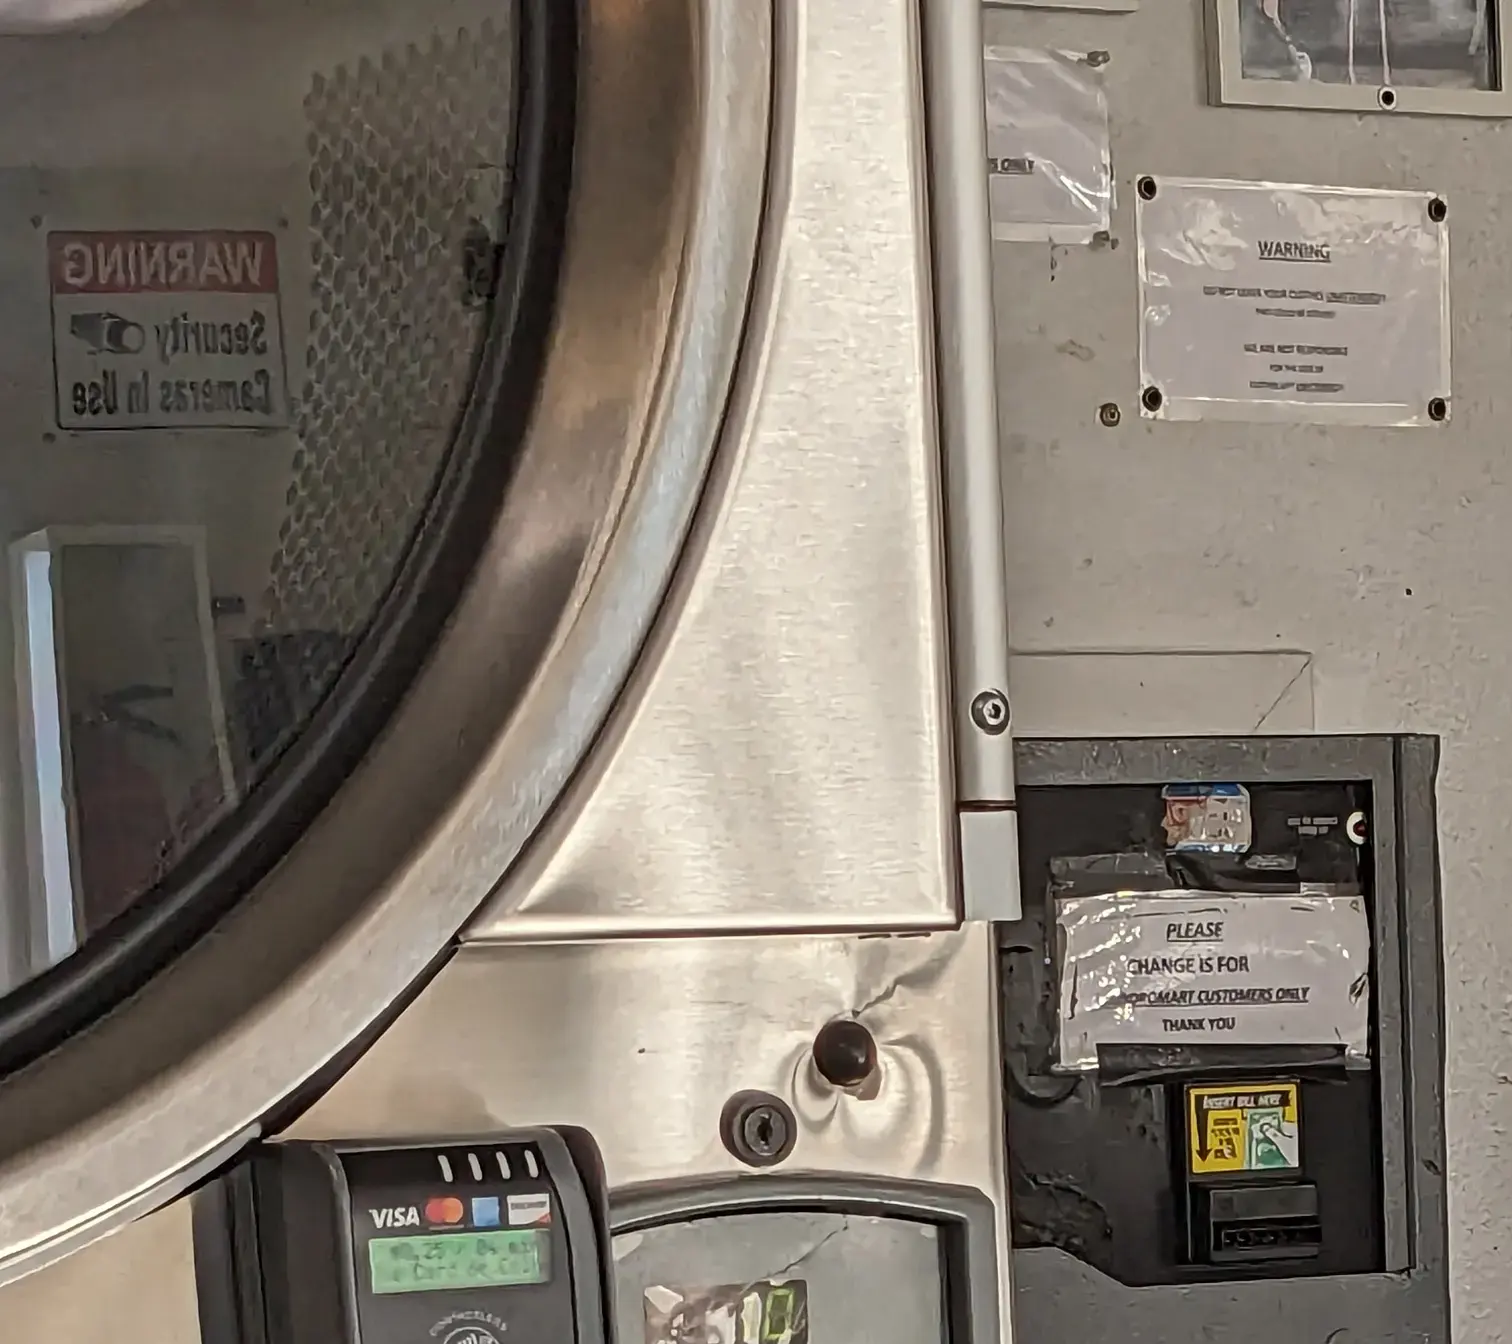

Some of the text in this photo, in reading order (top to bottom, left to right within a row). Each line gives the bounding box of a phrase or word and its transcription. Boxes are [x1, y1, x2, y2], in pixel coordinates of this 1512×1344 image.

[1258, 240, 1331, 259] WARNING
[1167, 922, 1224, 940] PLEASE
[1128, 956, 1250, 975] CHANGE IS FOR
[1162, 1017, 1236, 1032] THANK YOU
[369, 1206, 421, 1229] VISA
